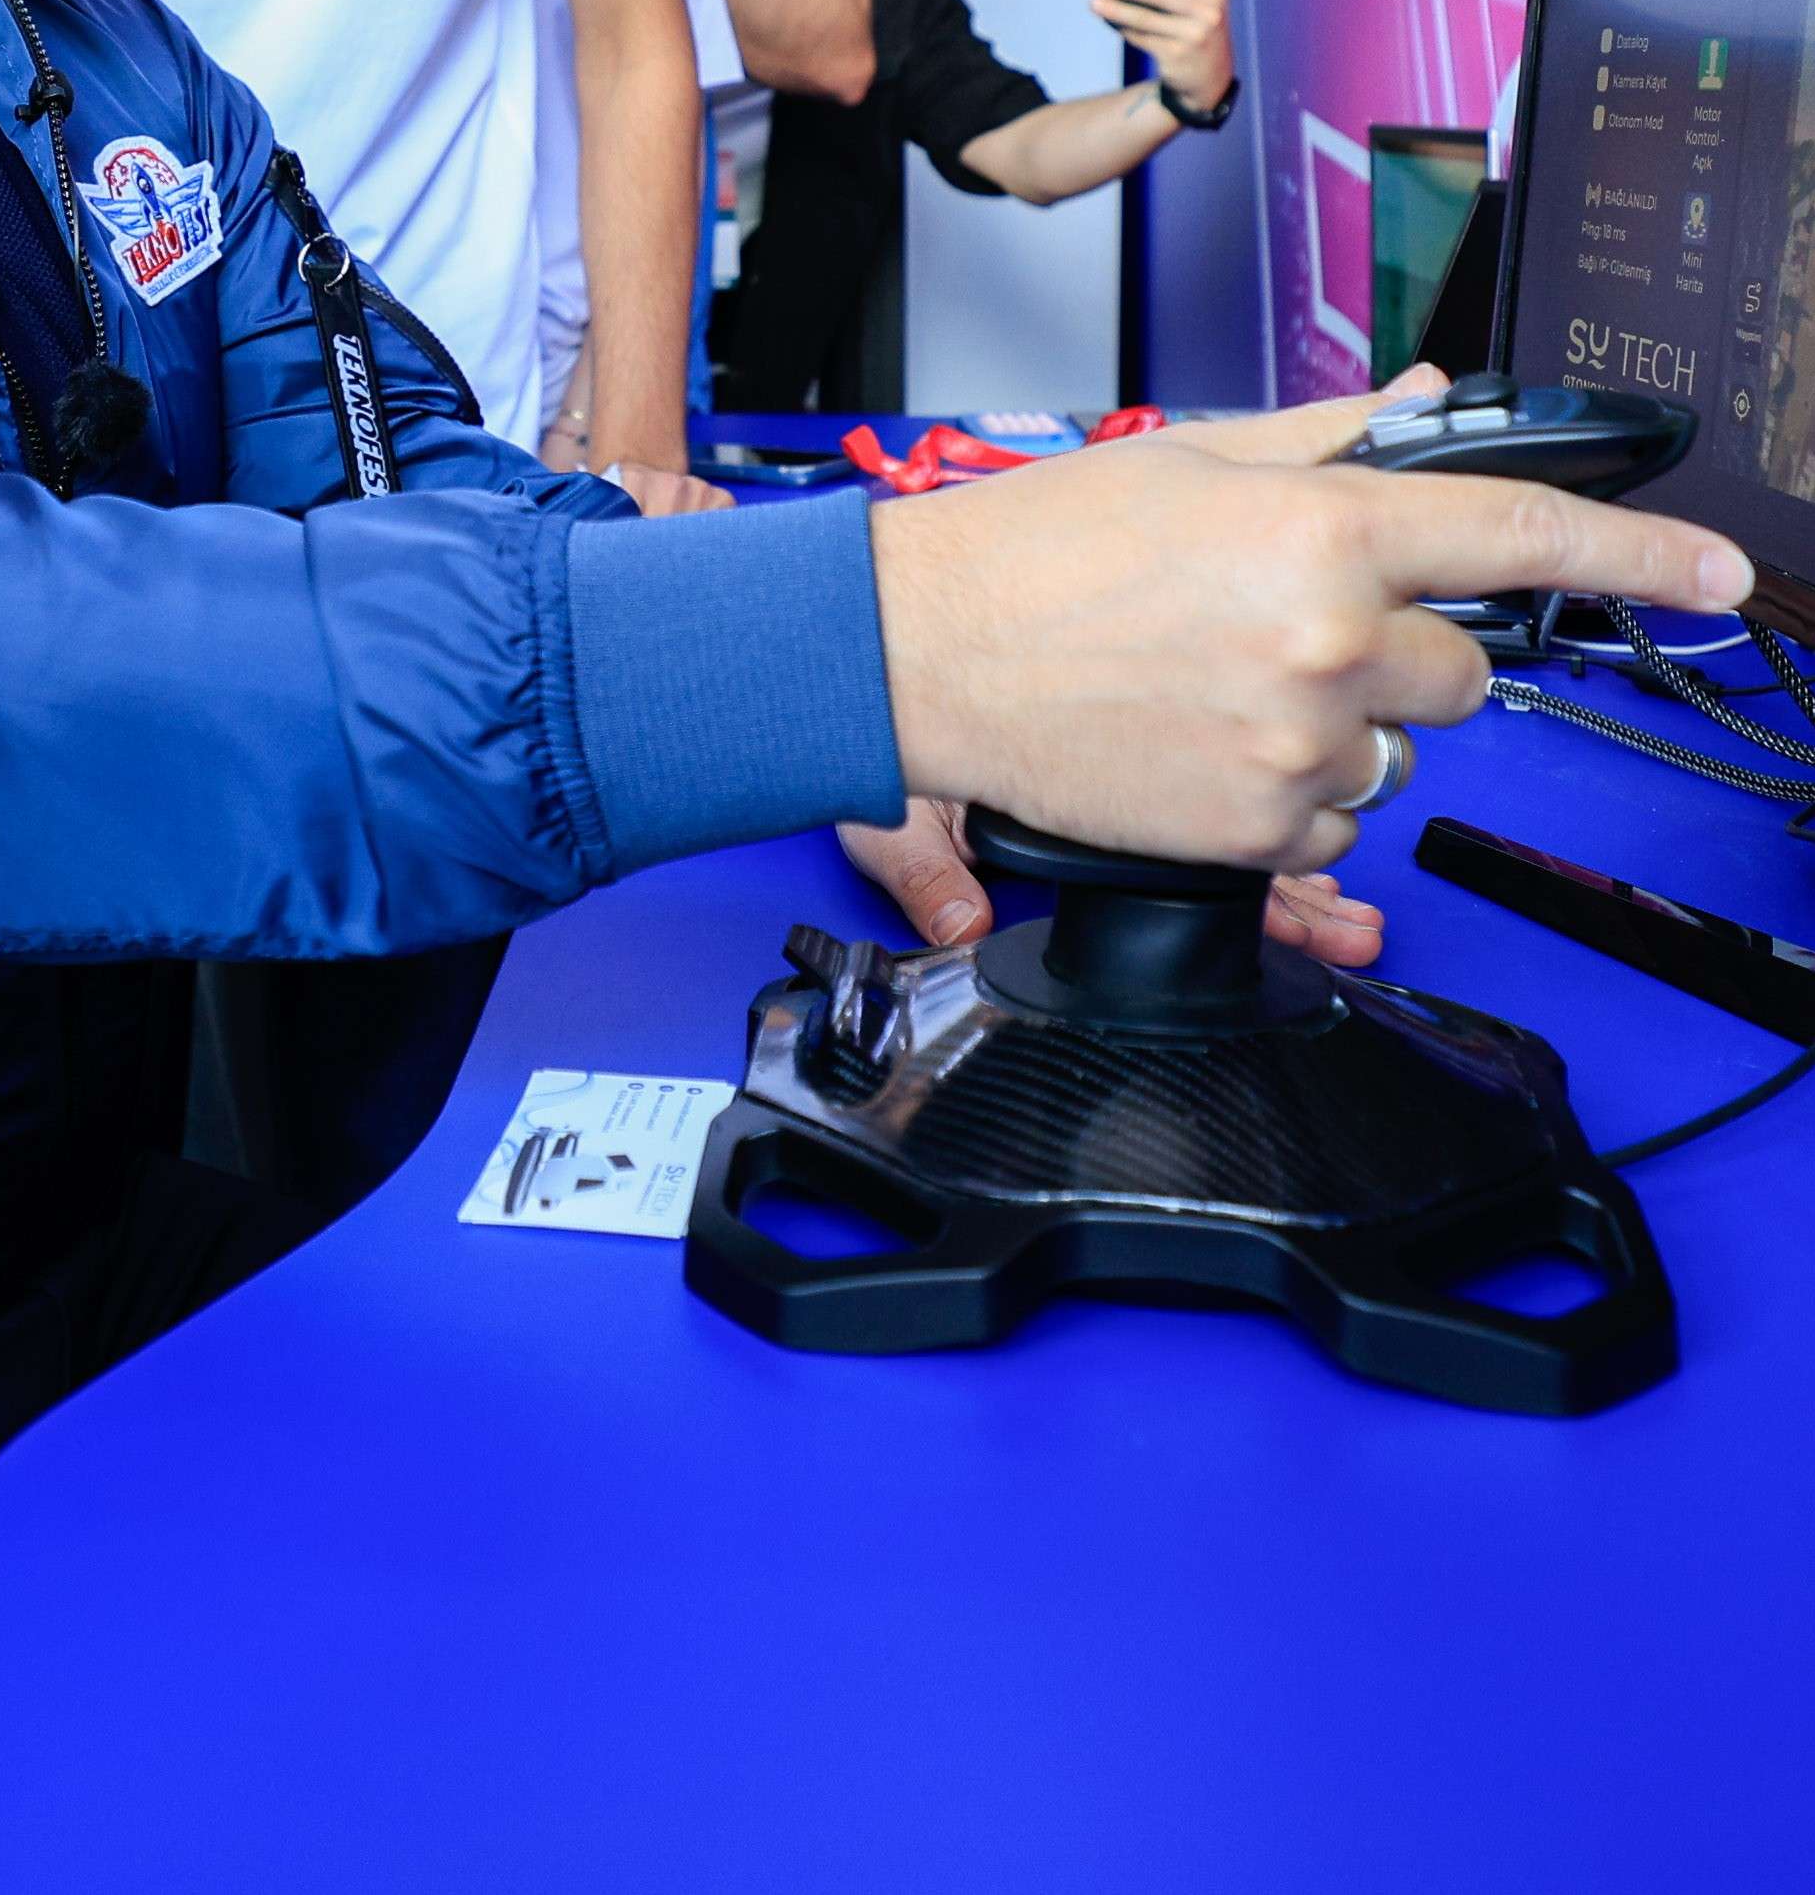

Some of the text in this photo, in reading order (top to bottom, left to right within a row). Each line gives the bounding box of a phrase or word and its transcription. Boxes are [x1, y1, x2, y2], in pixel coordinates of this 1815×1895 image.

[1616, 33, 1649, 53] Datalog
[1612, 73, 1645, 90] Kamera
[1608, 113, 1643, 130] Otonom
[1693, 105, 1722, 123] Motor
[1685, 129, 1720, 147] Kontrol
[1581, 219, 1601, 241] Ping:
[1612, 226, 1627, 242] ms
[122, 196, 214, 286] TEKNOFEST
[1681, 250, 1704, 270] Mini
[1675, 273, 1704, 294] Harita
[1618, 332, 1696, 397] TECH
[333, 331, 391, 501] TEKNOFES
